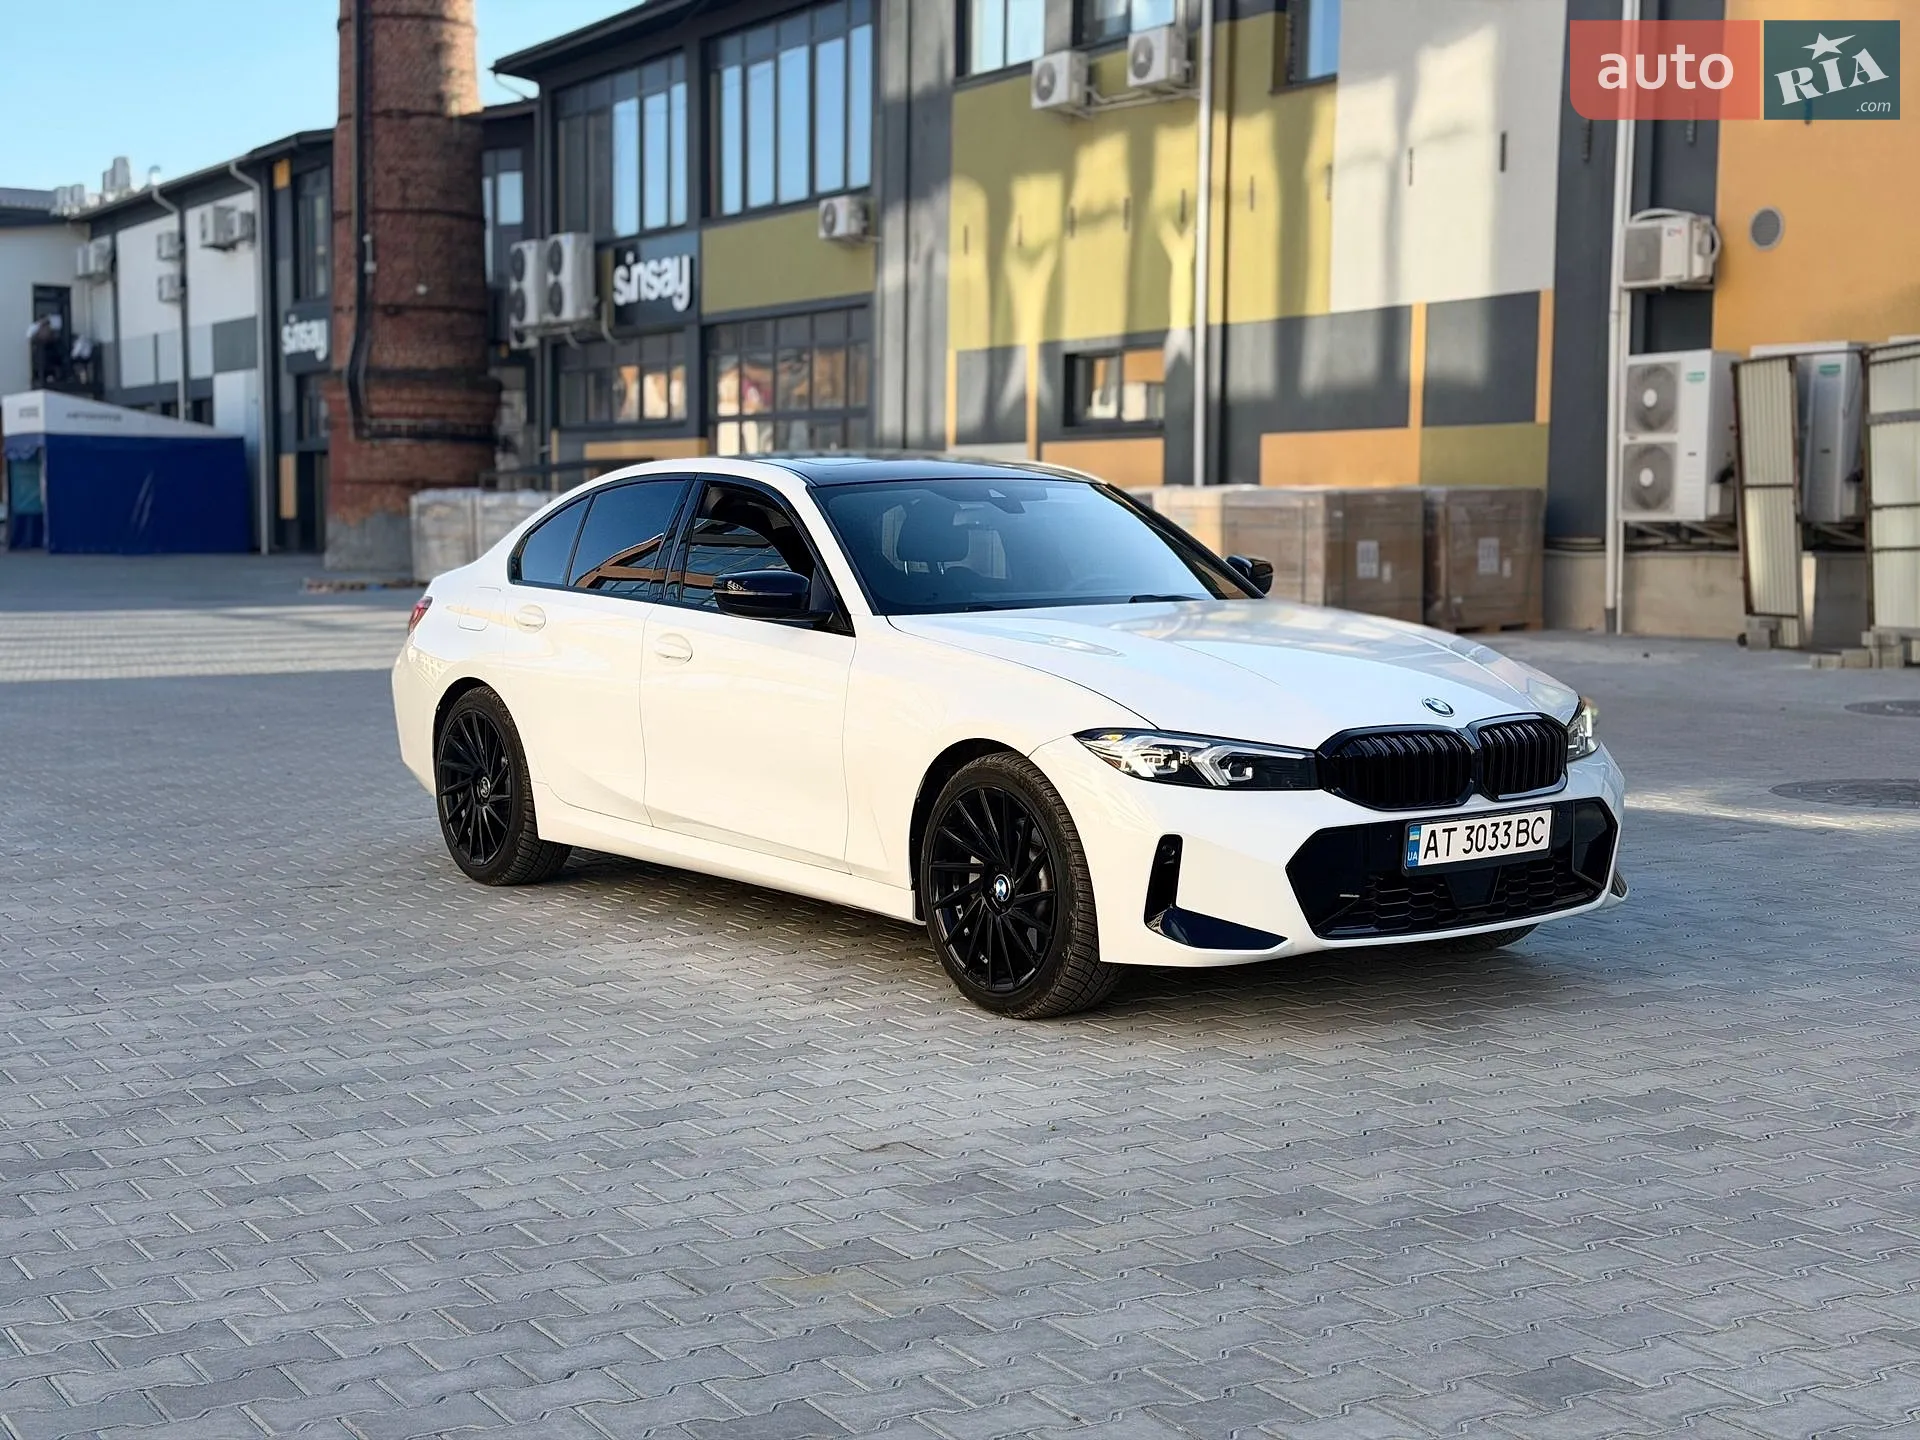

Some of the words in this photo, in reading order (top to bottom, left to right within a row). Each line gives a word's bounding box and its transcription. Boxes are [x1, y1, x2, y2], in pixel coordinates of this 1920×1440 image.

[613, 250, 690, 313] sinsay
[281, 313, 327, 362] sinsay
[1407, 851, 1418, 862] UA
[1423, 826, 1458, 860] AT
[1462, 820, 1512, 855] 3033
[1515, 816, 1546, 848] BC
